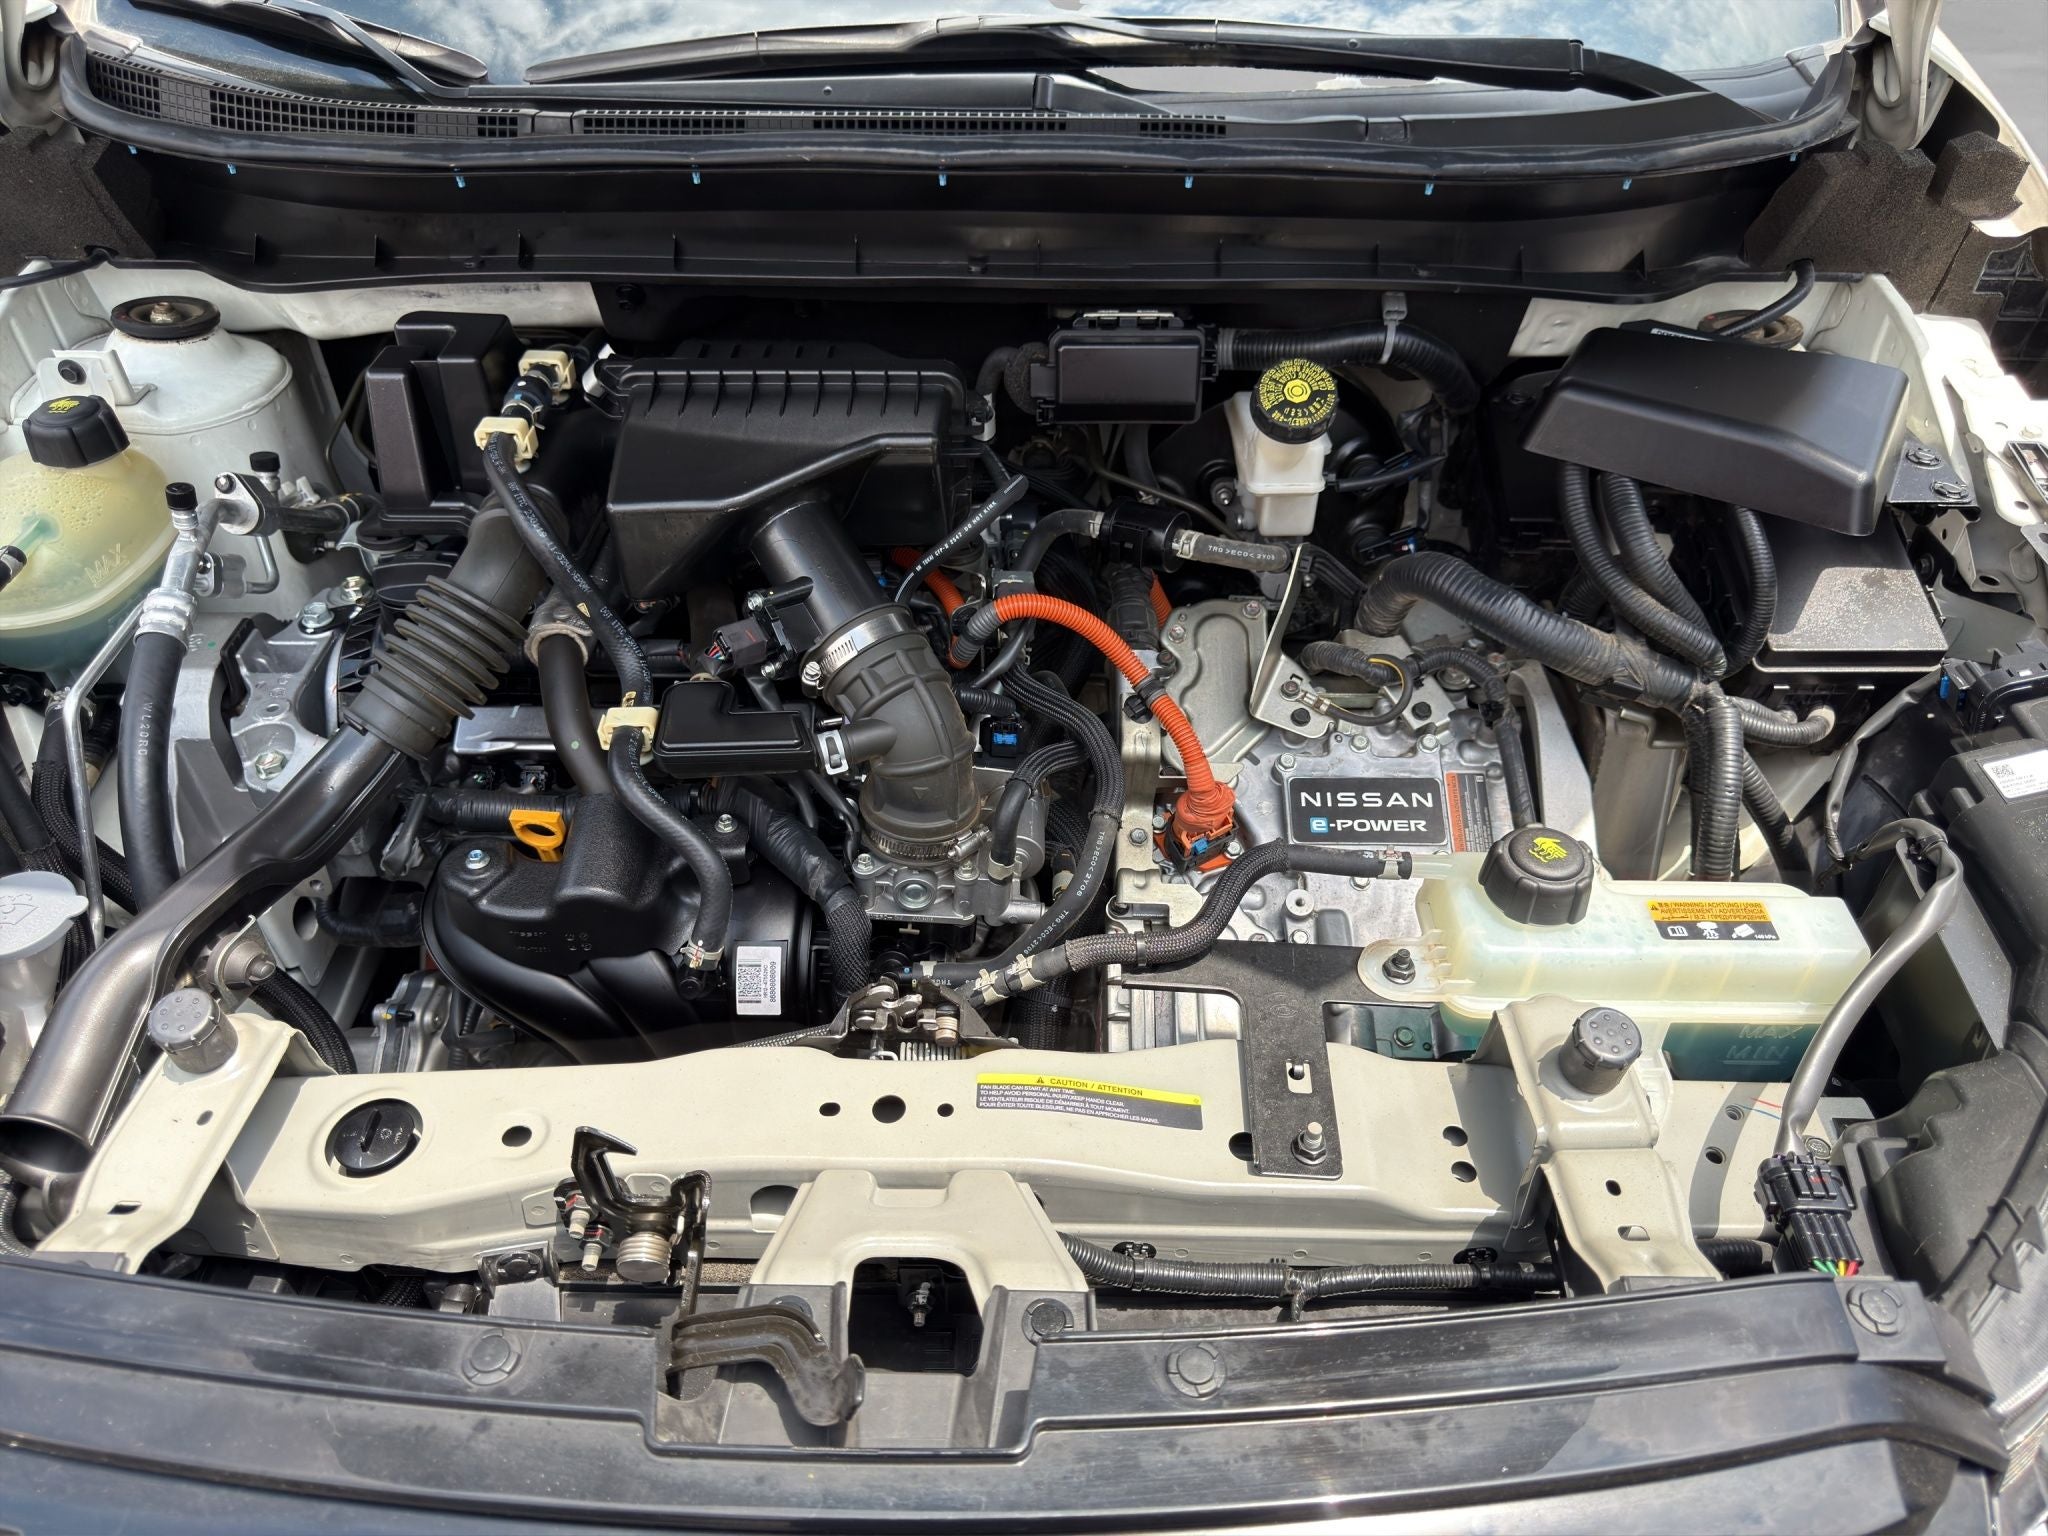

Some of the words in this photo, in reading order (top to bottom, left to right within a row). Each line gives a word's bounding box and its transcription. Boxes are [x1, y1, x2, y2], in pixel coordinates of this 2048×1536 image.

[964, 522, 972, 532] DO
[972, 513, 983, 525] NOT
[984, 500, 997, 514] KINK
[1300, 792, 1434, 808] NISSAN
[1311, 818, 1428, 832] e-POWER
[1739, 1024, 1804, 1039] MAX
[1726, 1045, 1790, 1060] MIN
[1050, 1078, 1088, 1088] CAUTION
[1097, 1084, 1143, 1096] ATTENTION
[1106, 1098, 1124, 1106] CLEAR.
[1095, 1110, 1129, 1119] APPROCHER
